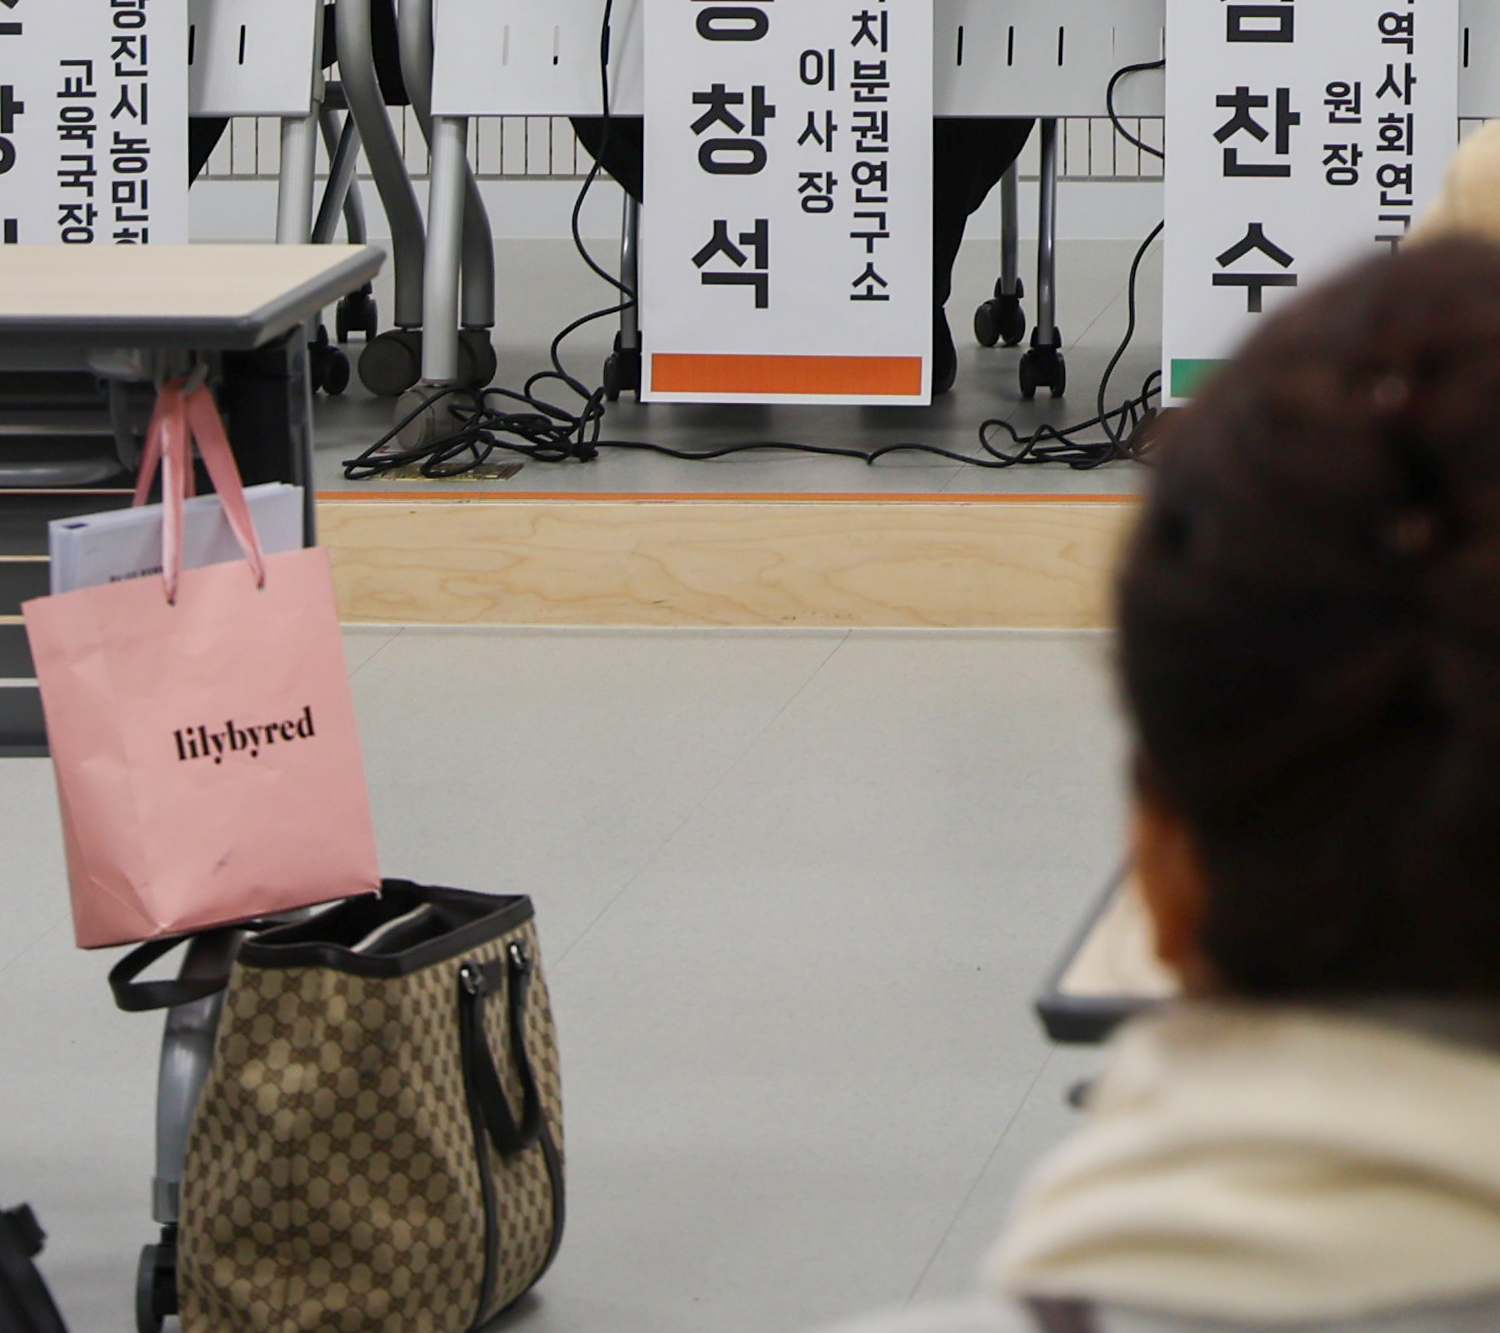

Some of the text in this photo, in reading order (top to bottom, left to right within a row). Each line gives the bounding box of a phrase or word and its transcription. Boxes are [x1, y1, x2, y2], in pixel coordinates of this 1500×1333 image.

[56, 59, 98, 244] 교육국장
[797, 48, 838, 215] 이사장
[1322, 81, 1363, 186] 원장
[173, 704, 316, 765] lilybyred
